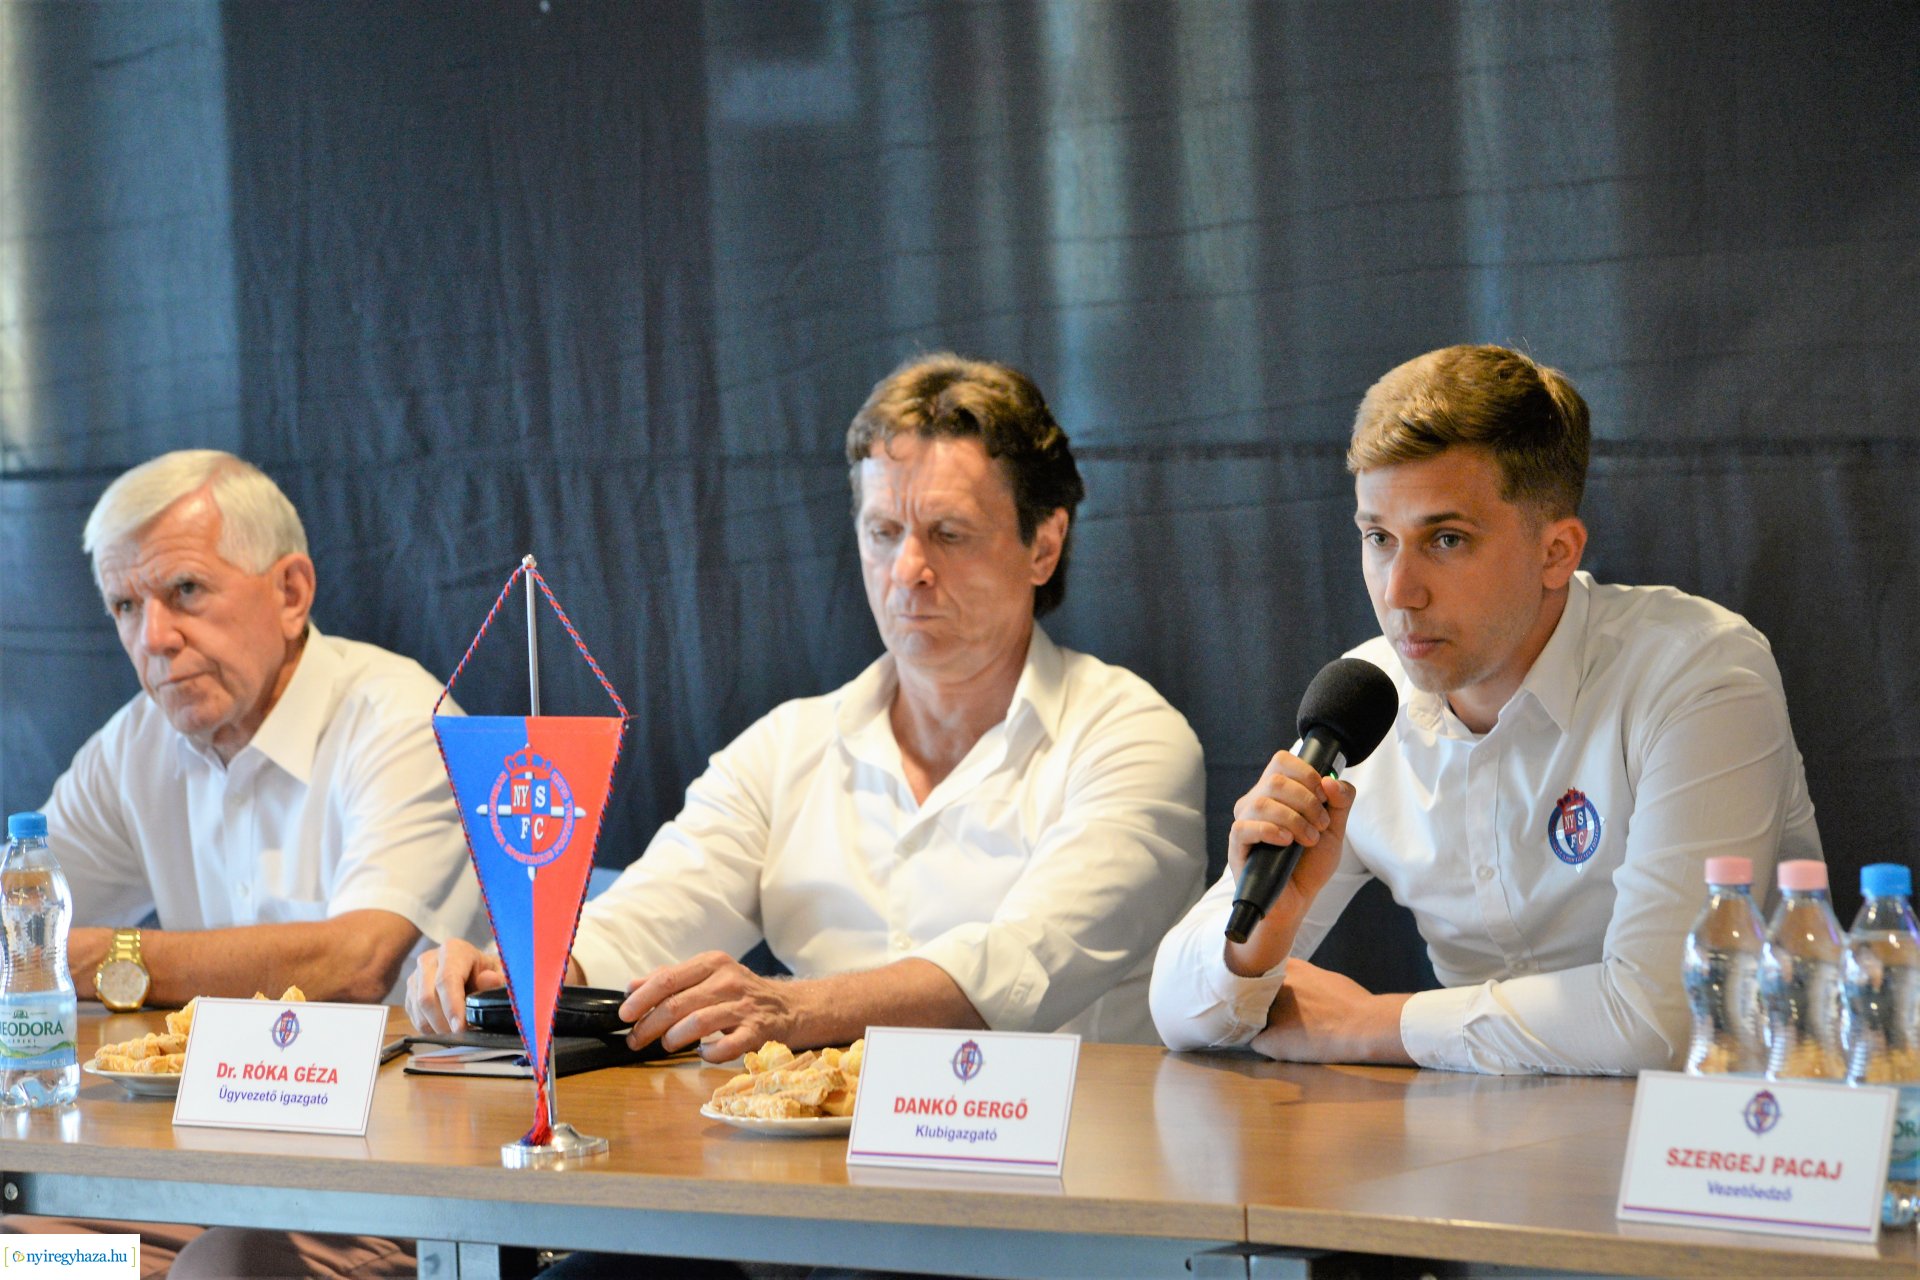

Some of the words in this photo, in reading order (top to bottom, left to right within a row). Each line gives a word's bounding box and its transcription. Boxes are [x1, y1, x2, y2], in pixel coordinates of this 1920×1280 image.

[513, 785, 529, 807] NY
[535, 785, 546, 807] S
[520, 817, 530, 839] F
[534, 818, 544, 839] C
[1564, 814, 1574, 830] NY
[1577, 811, 1584, 826] S
[1571, 833, 1577, 848] F
[1578, 831, 1584, 845] C
[0, 1020, 64, 1036] EODORA
[217, 1062, 237, 1079] Dr.
[242, 1060, 288, 1081] RÓKA
[294, 1063, 338, 1084] GÉZA
[219, 1084, 277, 1103] Ügyvezető
[280, 1090, 328, 1107] igazgató
[894, 1094, 958, 1117] DANKÓ
[964, 1098, 1029, 1120] GERGŐ
[915, 1124, 998, 1143] Klubigazgató
[1666, 1147, 1765, 1174] SZERGEJ
[1772, 1156, 1843, 1180] PACAJ
